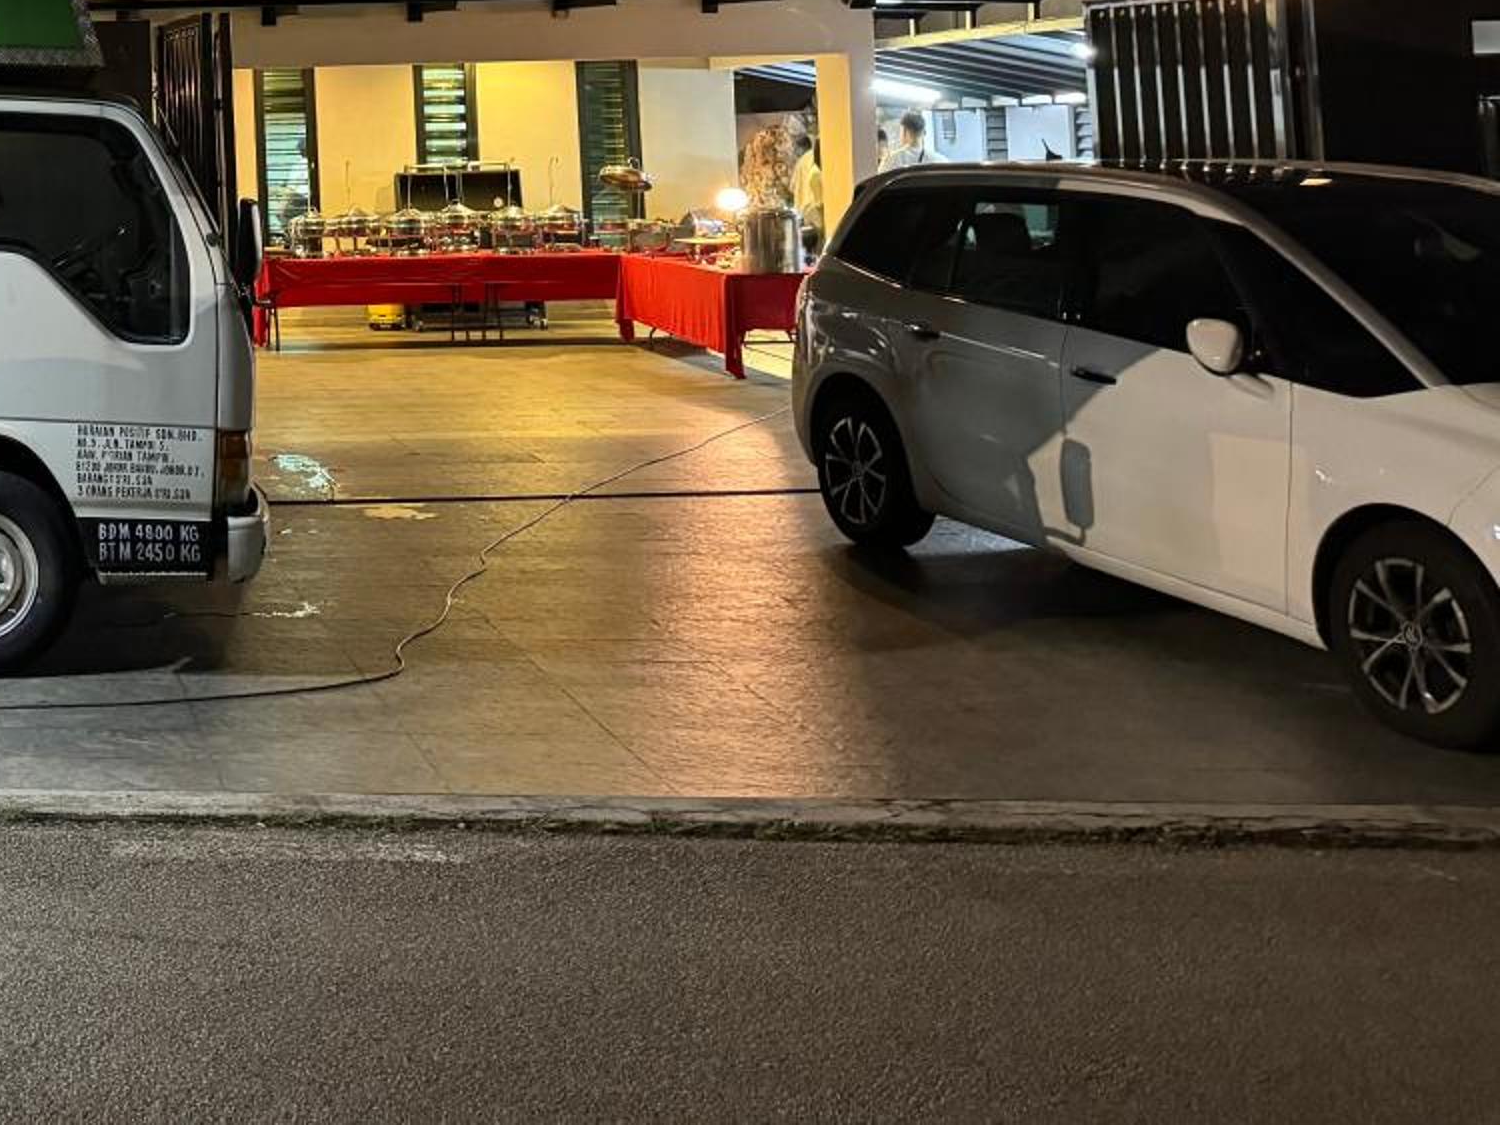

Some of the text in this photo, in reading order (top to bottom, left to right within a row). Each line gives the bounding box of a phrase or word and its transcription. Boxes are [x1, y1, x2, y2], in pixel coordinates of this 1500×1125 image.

[99, 523, 199, 541] BDM 4800 KG
[99, 541, 201, 562] BTM 2450 KG
